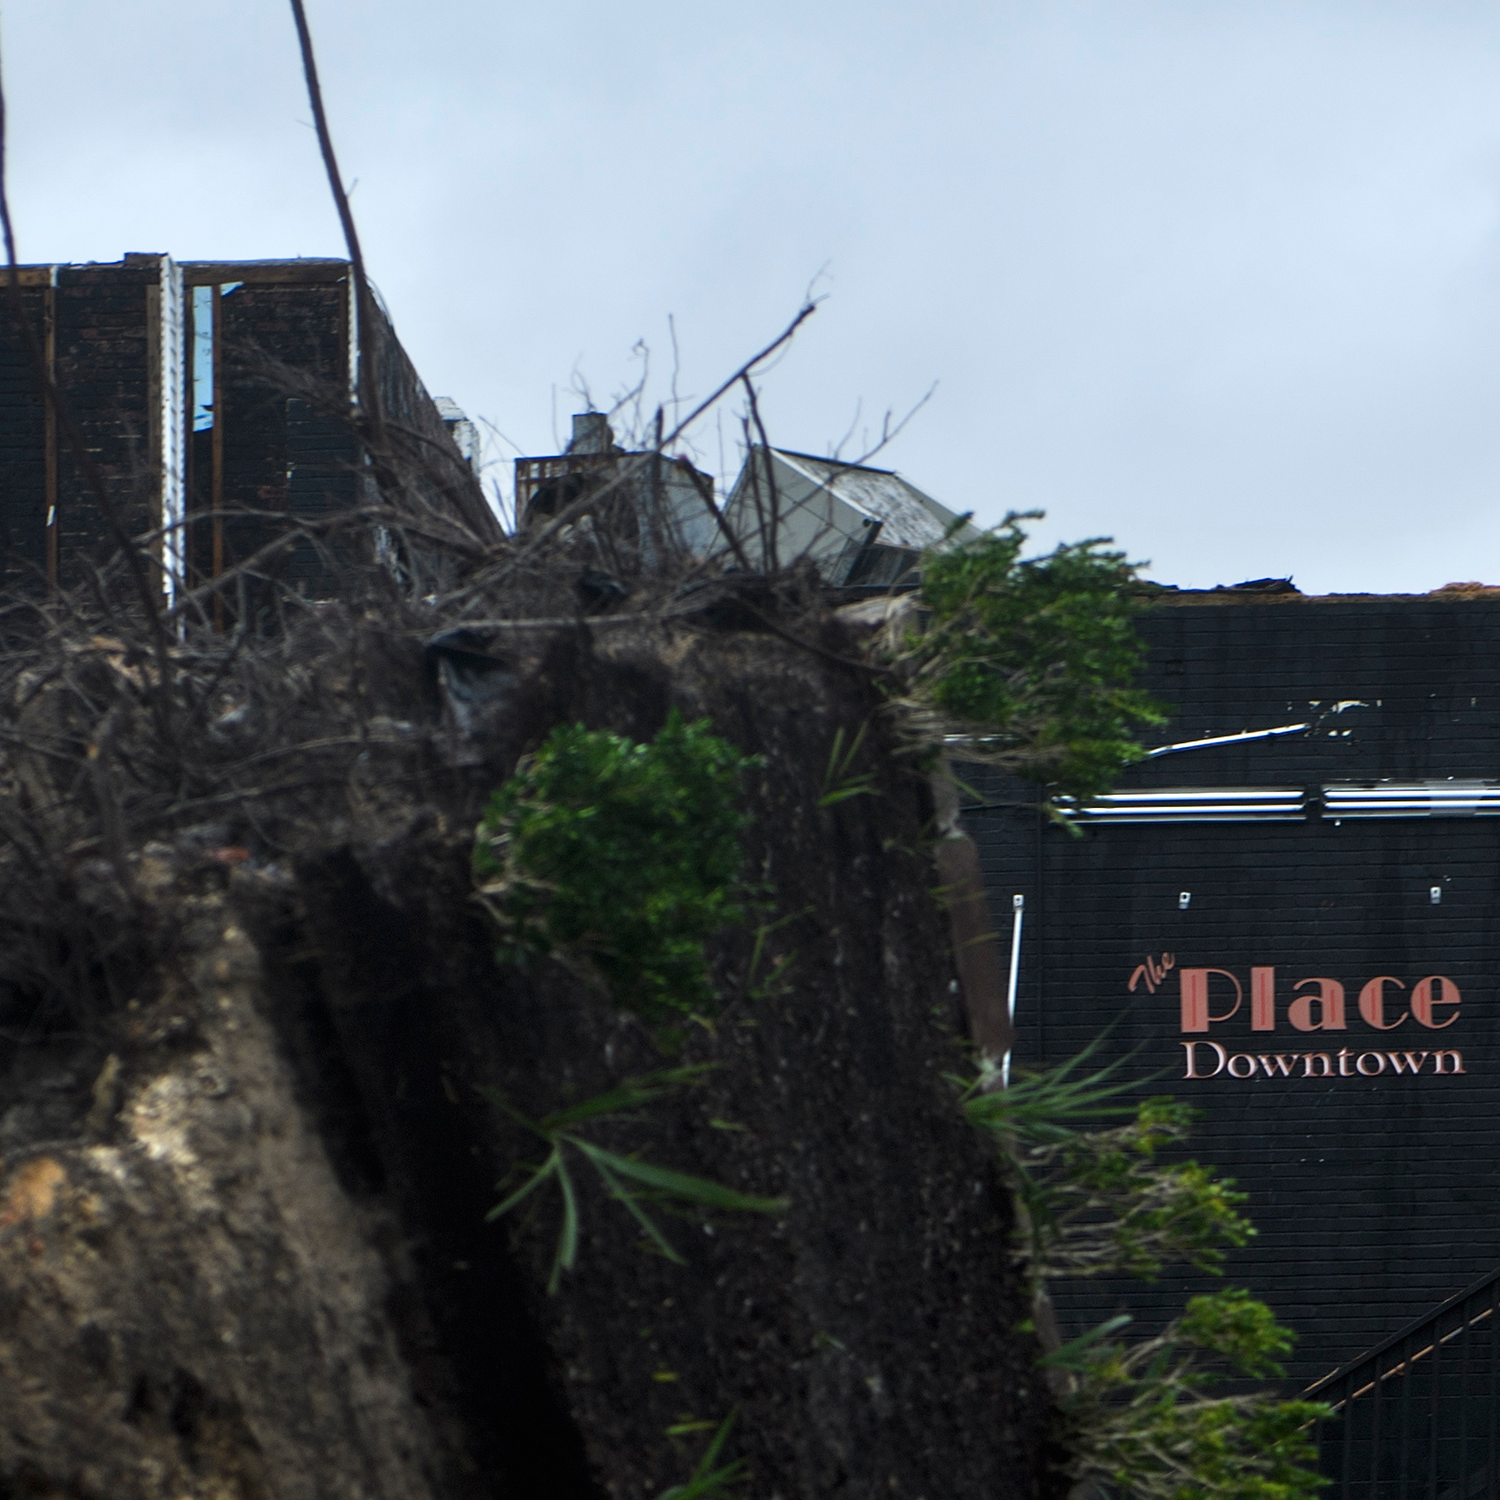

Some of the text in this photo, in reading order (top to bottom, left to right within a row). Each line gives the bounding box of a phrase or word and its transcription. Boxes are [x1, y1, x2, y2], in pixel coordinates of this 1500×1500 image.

[1128, 952, 1462, 1033] The Place
[1179, 1040, 1467, 1080] Downtown
